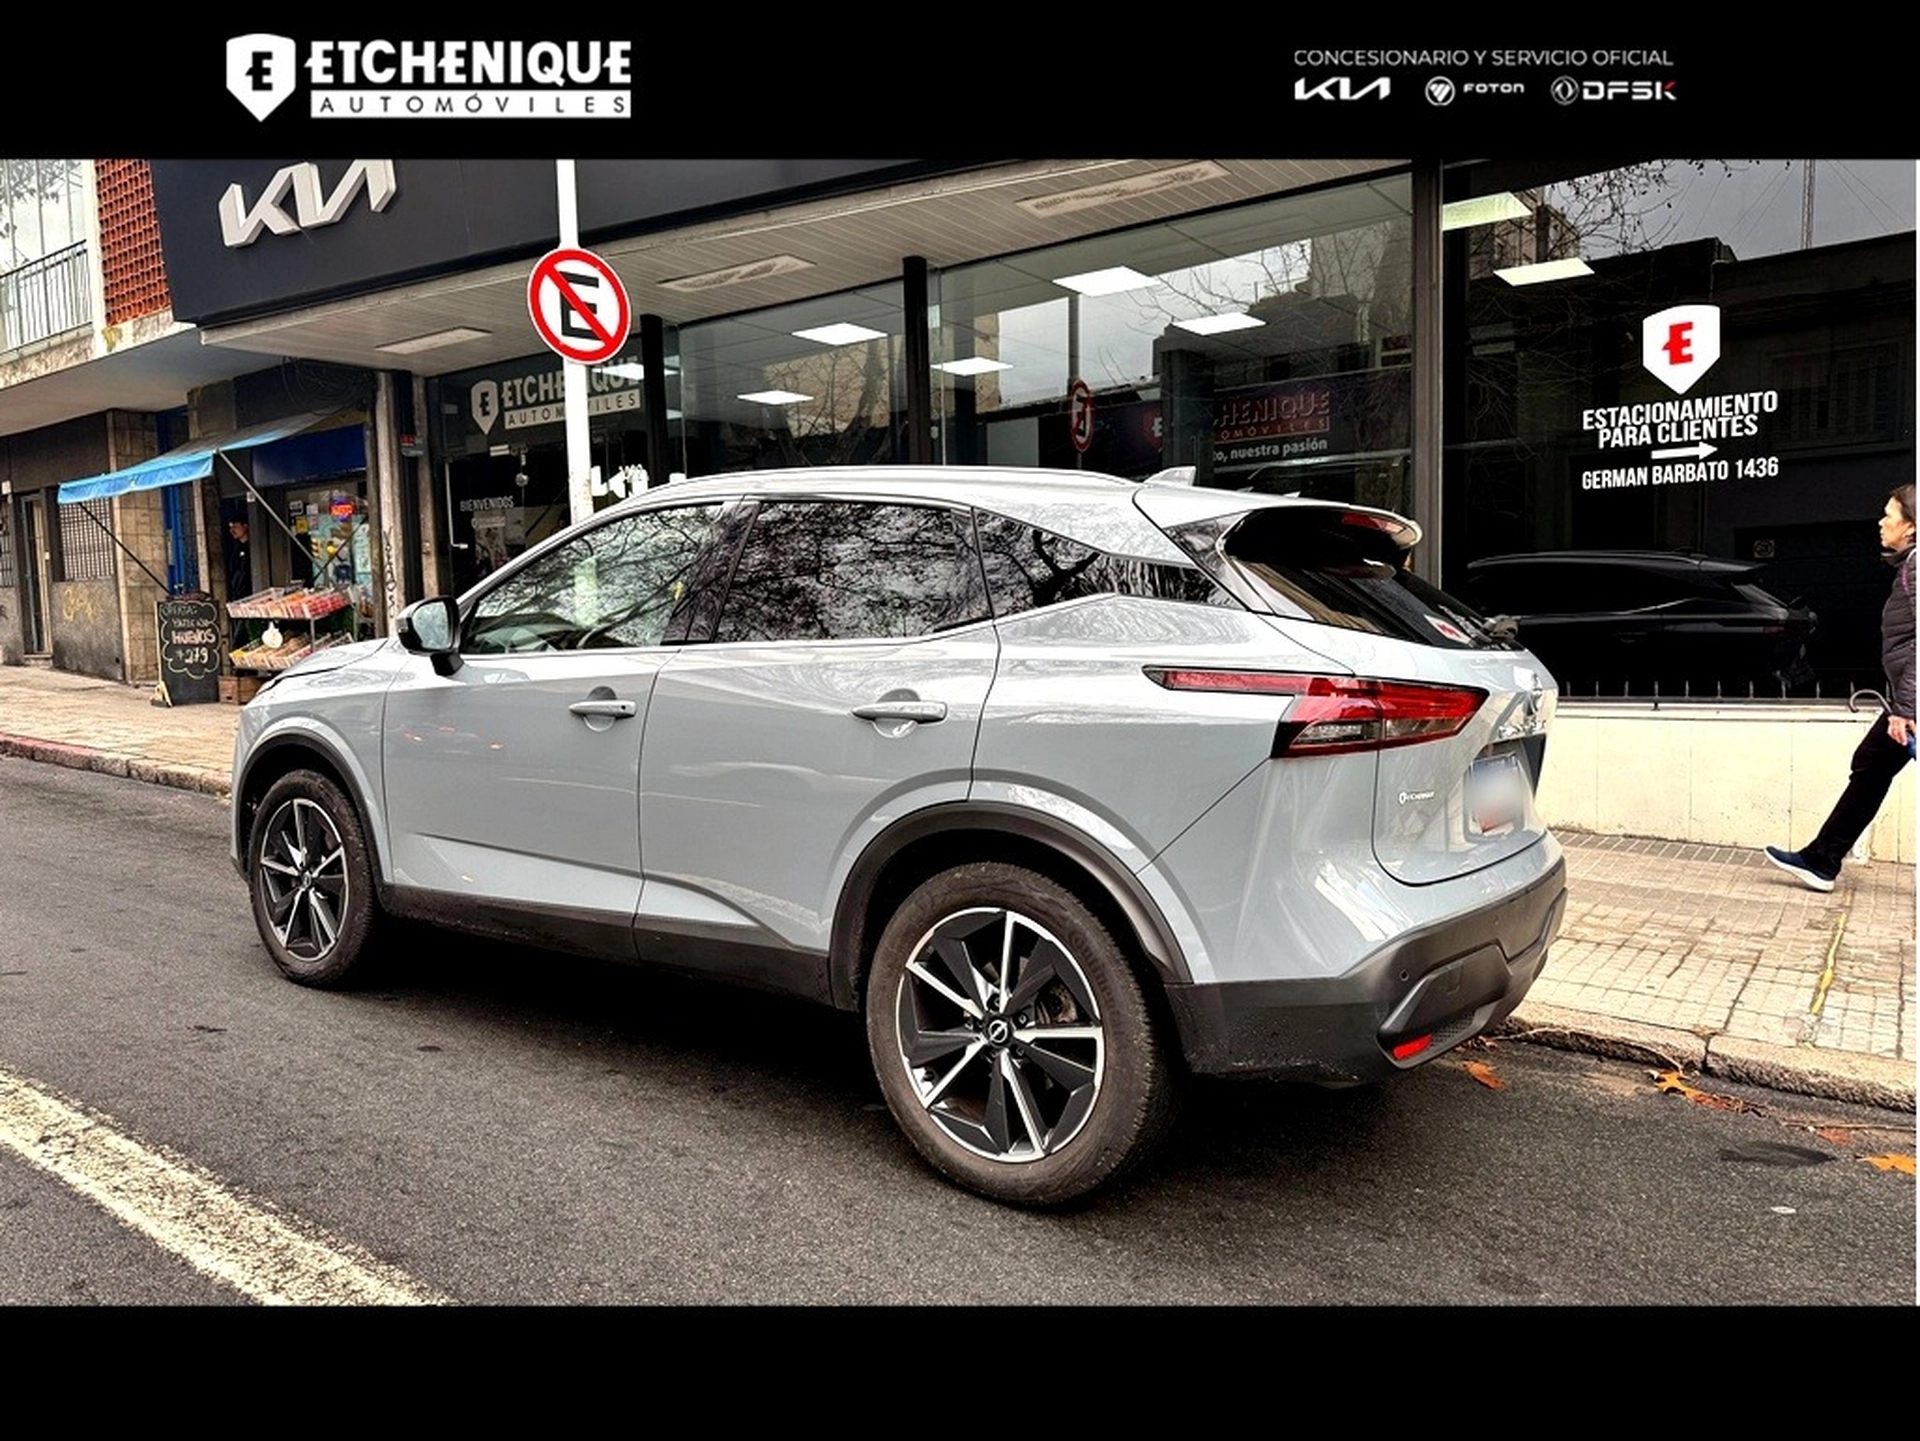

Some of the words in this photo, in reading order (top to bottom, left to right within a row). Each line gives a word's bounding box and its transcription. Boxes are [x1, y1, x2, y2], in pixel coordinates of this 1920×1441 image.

[559, 271, 603, 341] E
[1582, 390, 1779, 430] ESTACIONAMIENTO
[1230, 443, 1280, 459] nuestra
[1282, 436, 1328, 457] pasión
[1598, 423, 1653, 449] PARA
[1657, 414, 1759, 444] CLIENTES
[1582, 466, 1648, 490] GERMAN
[1652, 460, 1729, 485] BARBATO
[1735, 456, 1779, 479] 1436
